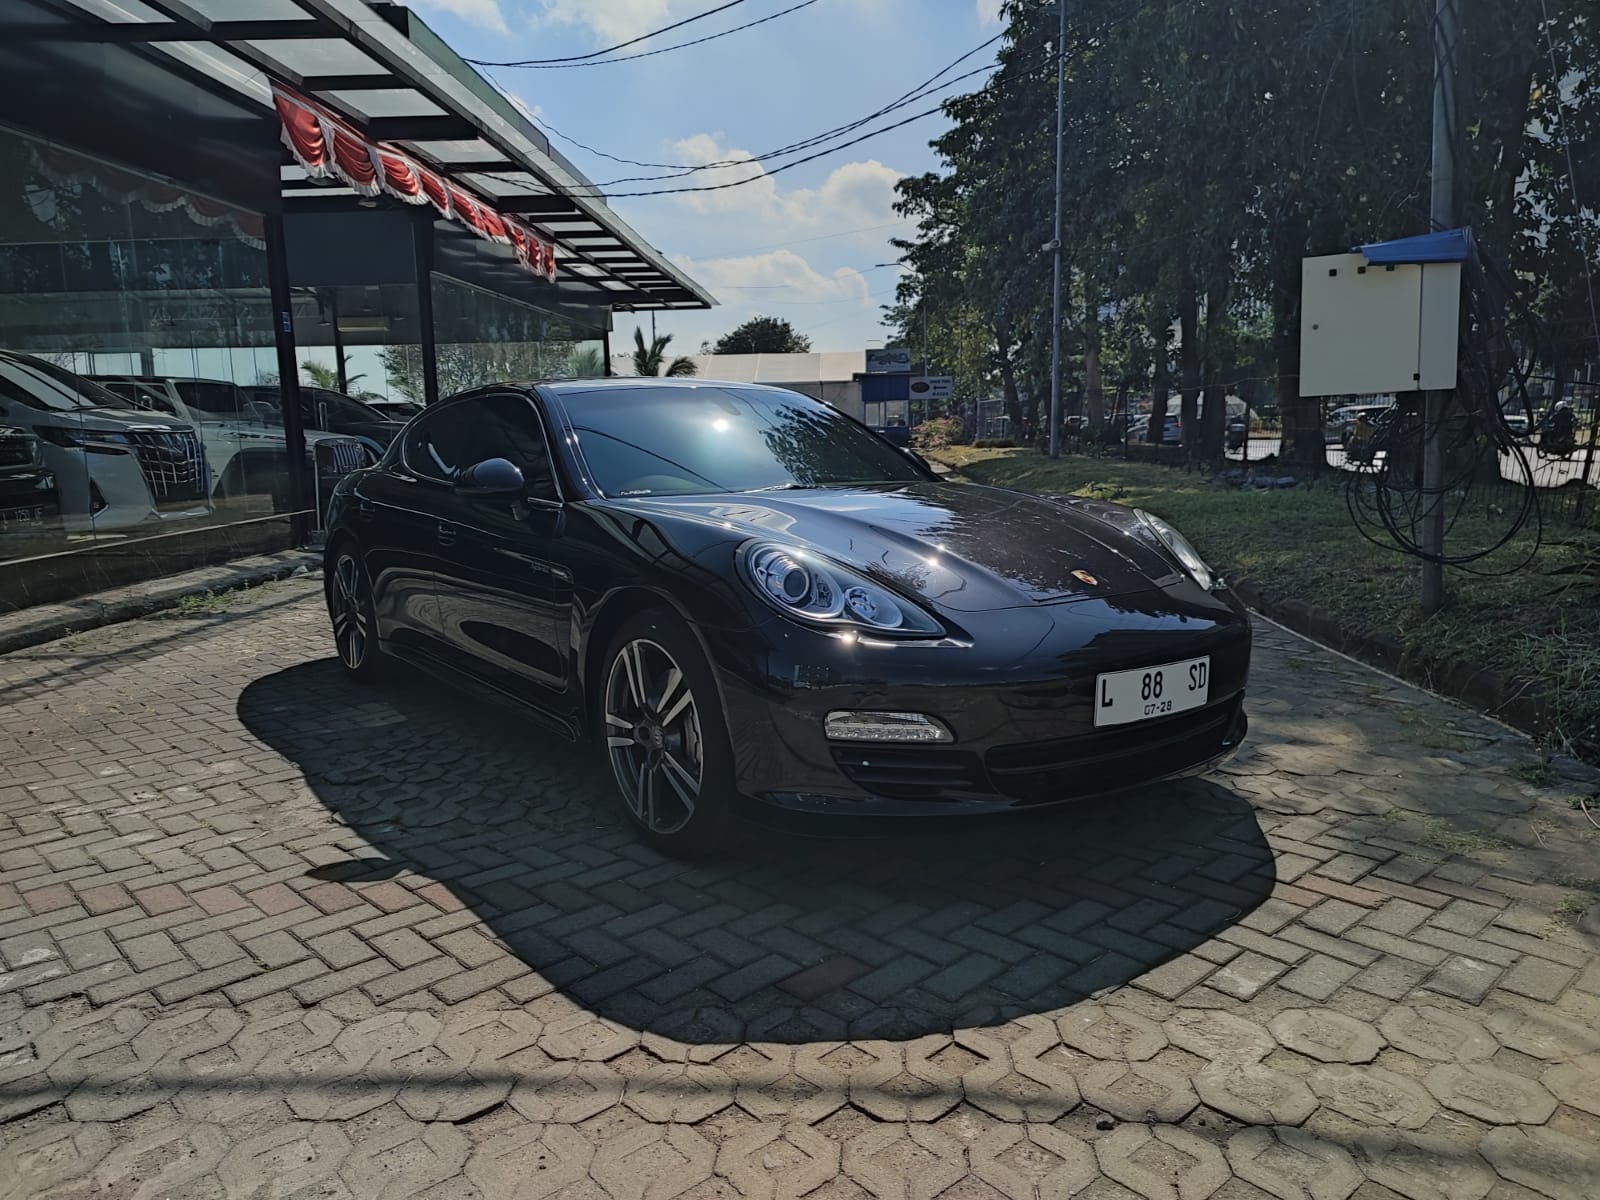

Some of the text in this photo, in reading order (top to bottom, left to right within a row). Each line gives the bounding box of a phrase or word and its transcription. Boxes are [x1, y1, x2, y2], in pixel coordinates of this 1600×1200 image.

[1101, 662, 1207, 707] L 88 SD
[1144, 700, 1172, 716] 07-28
